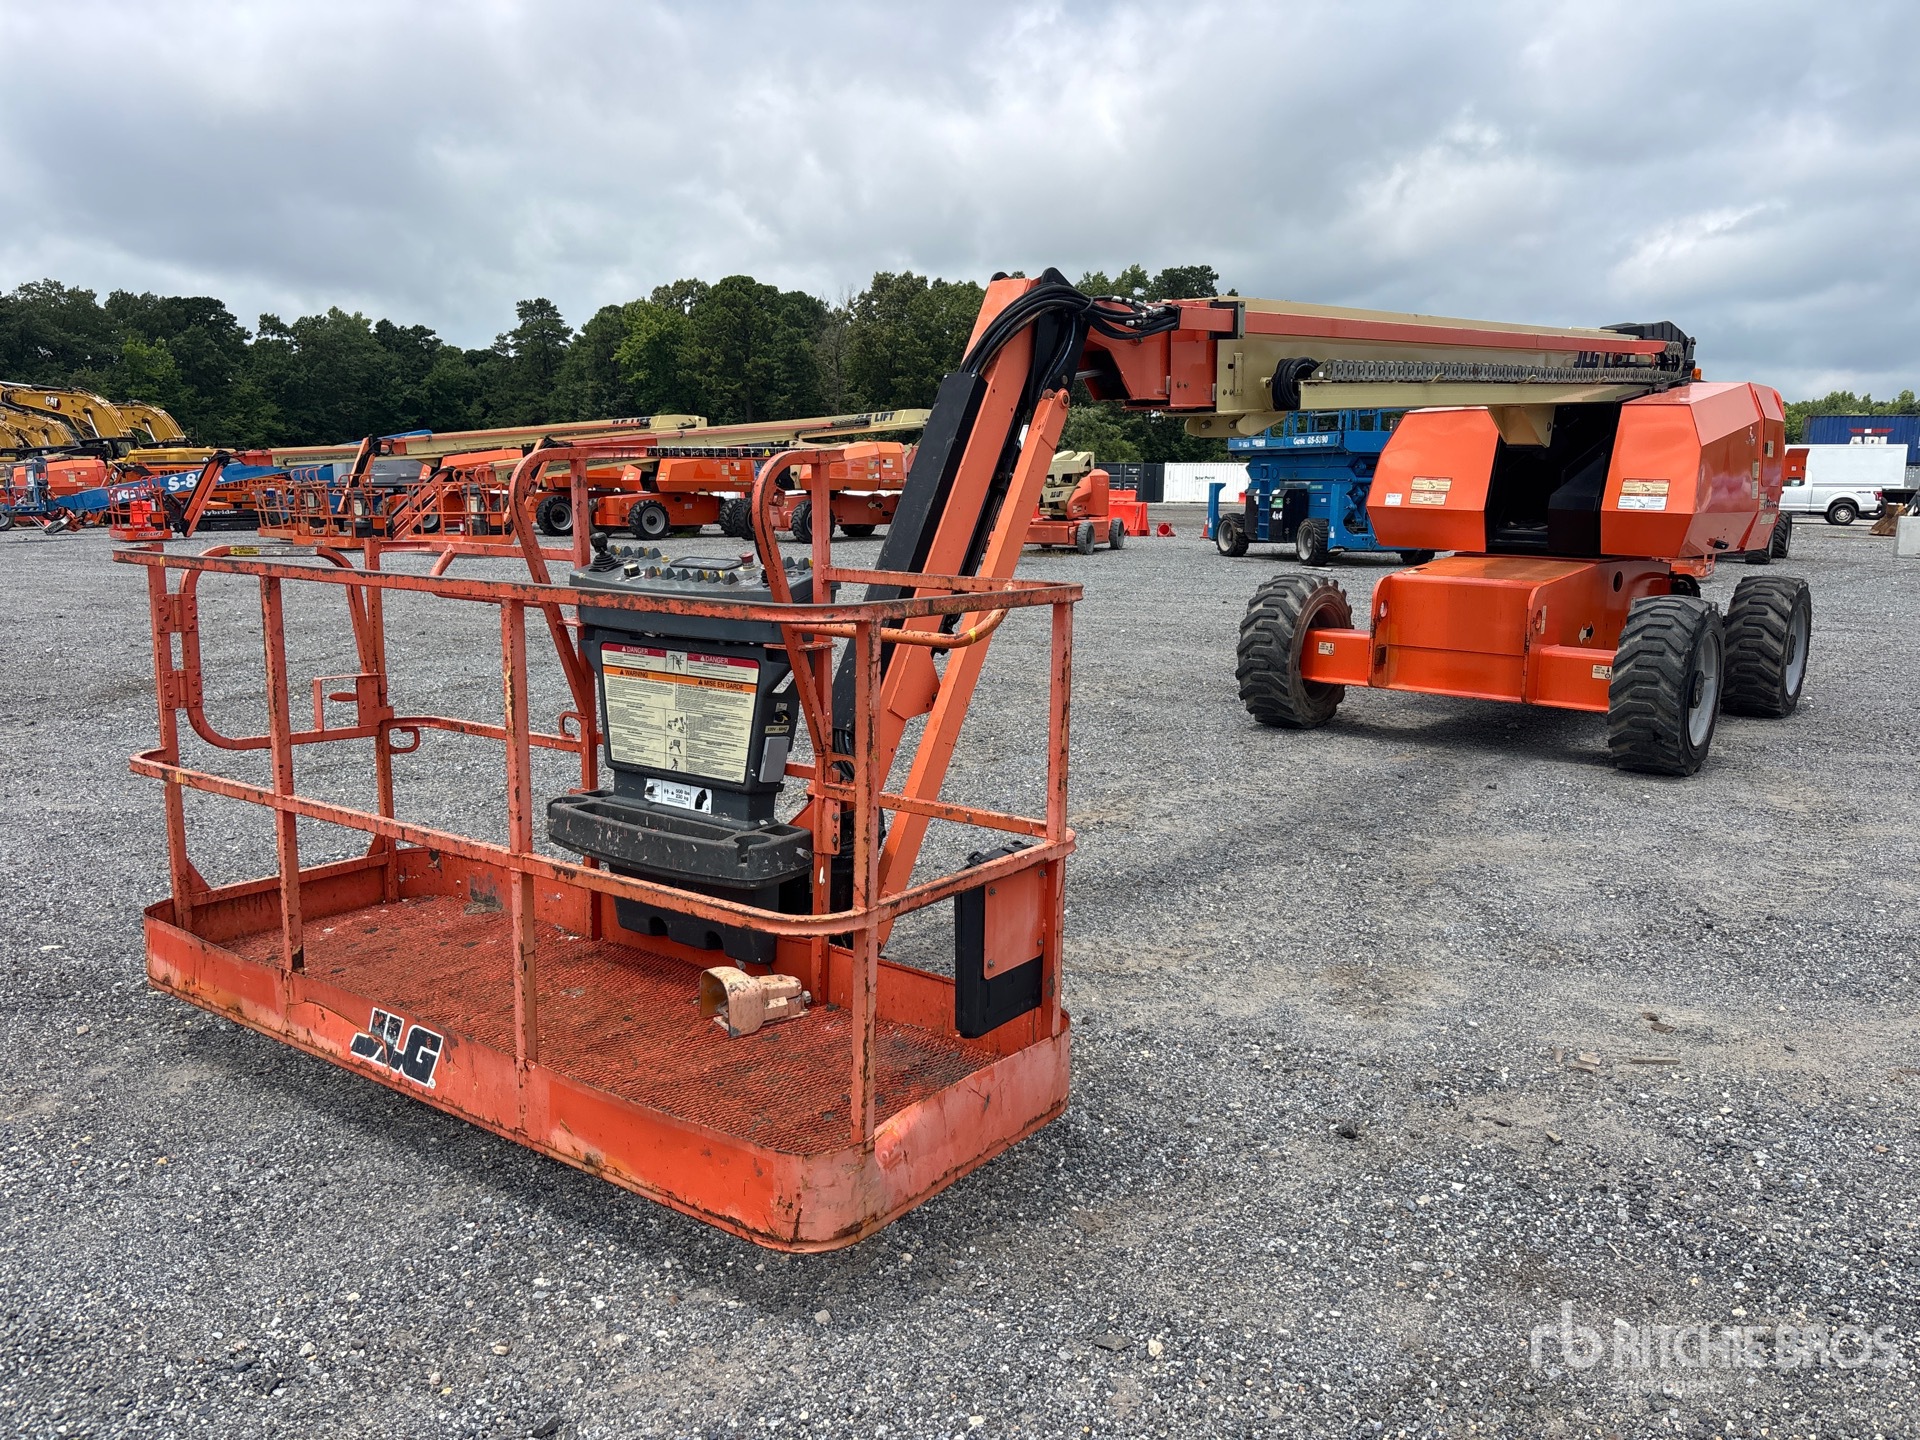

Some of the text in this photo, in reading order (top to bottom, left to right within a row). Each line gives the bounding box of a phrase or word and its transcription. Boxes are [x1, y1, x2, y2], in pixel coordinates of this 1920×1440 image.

[45, 396, 58, 407] CAT
[874, 412, 895, 422] LIFT
[626, 646, 649, 655] DANGER
[705, 656, 729, 665] DANGER
[625, 669, 649, 679] WARNING
[725, 682, 744, 691] GARDE
[350, 1007, 444, 1088] JLG
